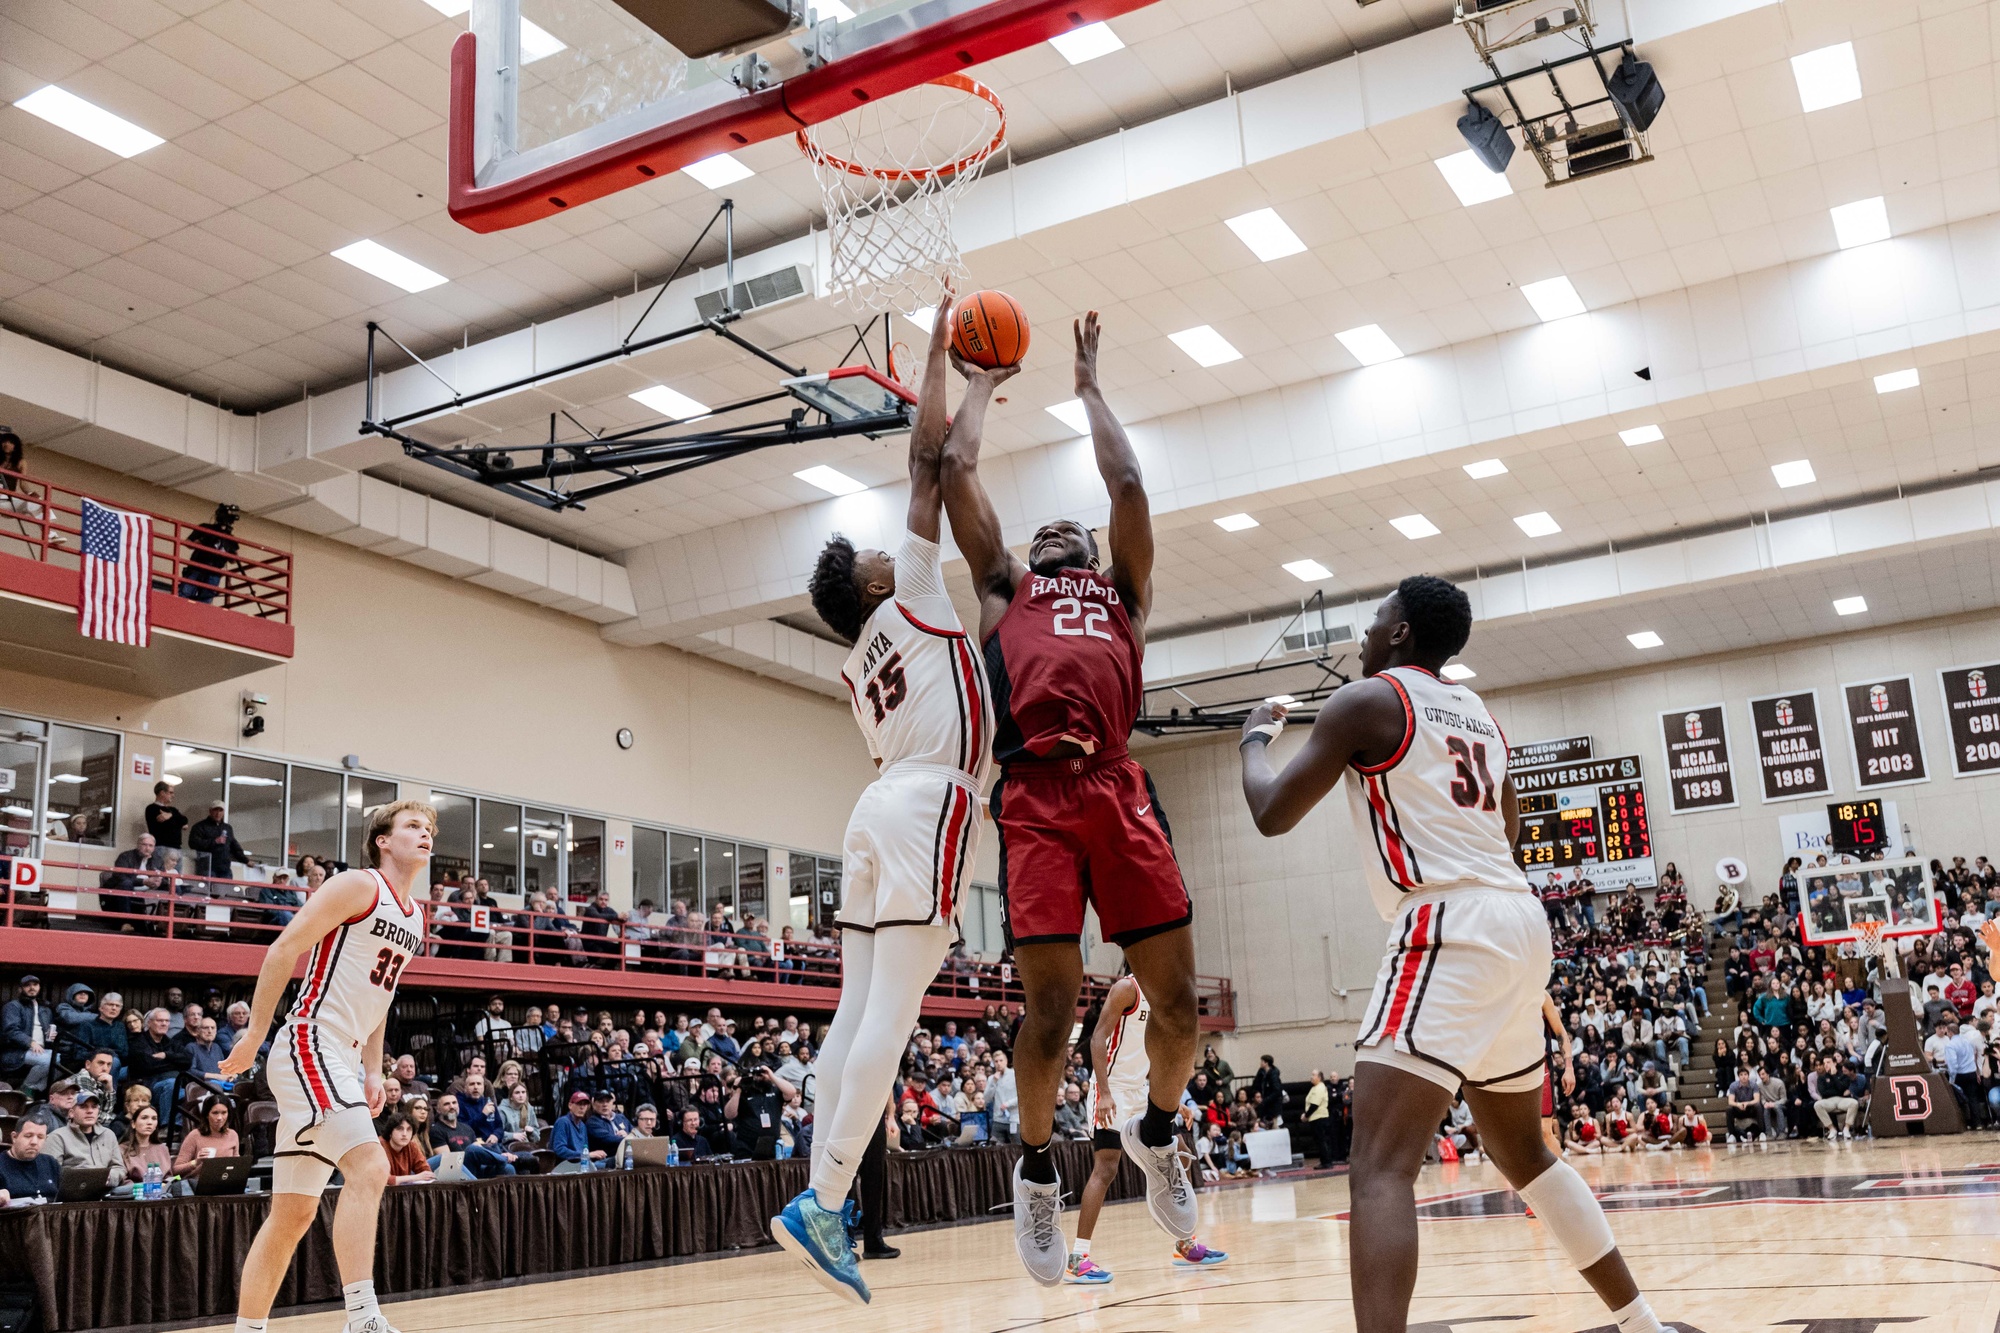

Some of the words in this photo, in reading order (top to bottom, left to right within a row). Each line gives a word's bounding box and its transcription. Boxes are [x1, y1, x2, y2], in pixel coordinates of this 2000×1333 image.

[962, 308, 984, 353] ELITE
[1051, 597, 1113, 641] 22
[863, 631, 893, 680] ANYA
[865, 650, 907, 728] 15
[1954, 701, 1971, 709] MEN'S
[1857, 715, 1874, 724] MEN'S
[1874, 710, 1909, 721] BASKETBALL
[1969, 713, 2000, 734] CBI
[1780, 724, 1813, 735] BASKETBALL
[1871, 728, 1899, 748] NIT
[1510, 749, 1520, 759] A.
[1523, 742, 1570, 757] FRIEDMAN
[1573, 739, 1588, 748] '79
[1689, 737, 1720, 748] BASKETBALL
[1771, 737, 1808, 755] NCAA
[1073, 761, 1081, 770] H
[1681, 750, 1716, 767] NCAA
[1762, 749, 1821, 767] TOURNAMENT
[1868, 754, 1913, 775] 2003
[134, 761, 151, 775] EE
[1445, 735, 1497, 812] 31
[1514, 763, 1616, 790] UNIVERSITY
[1671, 762, 1728, 779] TOURNAMENT
[1774, 767, 1815, 788] 1986
[1682, 780, 1722, 800] 1939
[1608, 796, 1616, 807] 0
[1619, 795, 1627, 806] 0
[1635, 792, 1643, 804] 0
[1610, 809, 1617, 820] 2
[1620, 808, 1628, 819] 0
[1634, 805, 1644, 817] 12
[1838, 802, 1878, 820] 18:17
[1525, 819, 1544, 827] PERIOD
[1571, 819, 1593, 837] 24
[1608, 822, 1619, 833] 10
[1622, 821, 1630, 832] 0
[1639, 818, 1647, 830] 5
[1853, 818, 1875, 843] 15
[1531, 826, 1540, 840] 2
[1607, 835, 1621, 847] 22
[1624, 834, 1631, 846] 2
[1640, 832, 1648, 842] 4
[615, 840, 624, 850] FF
[1523, 849, 1532, 864] 2
[1536, 847, 1554, 862] 23
[1564, 844, 1573, 859] 3
[1586, 841, 1596, 856] 0
[1609, 848, 1623, 860] 23
[1628, 848, 1633, 857] 1
[1642, 845, 1650, 857] 3
[15, 862, 37, 886] D
[776, 866, 783, 875] FF
[1596, 864, 1636, 875] LEXUS
[1723, 864, 1741, 879] B
[1607, 879, 1617, 887] OF
[1618, 875, 1653, 885] WARWICK
[475, 911, 486, 928] E
[370, 918, 421, 954] BROWN
[774, 943, 781, 956] F
[369, 947, 405, 992] 33
[1003, 968, 1009, 979] G
[1889, 1075, 1932, 1121] B
